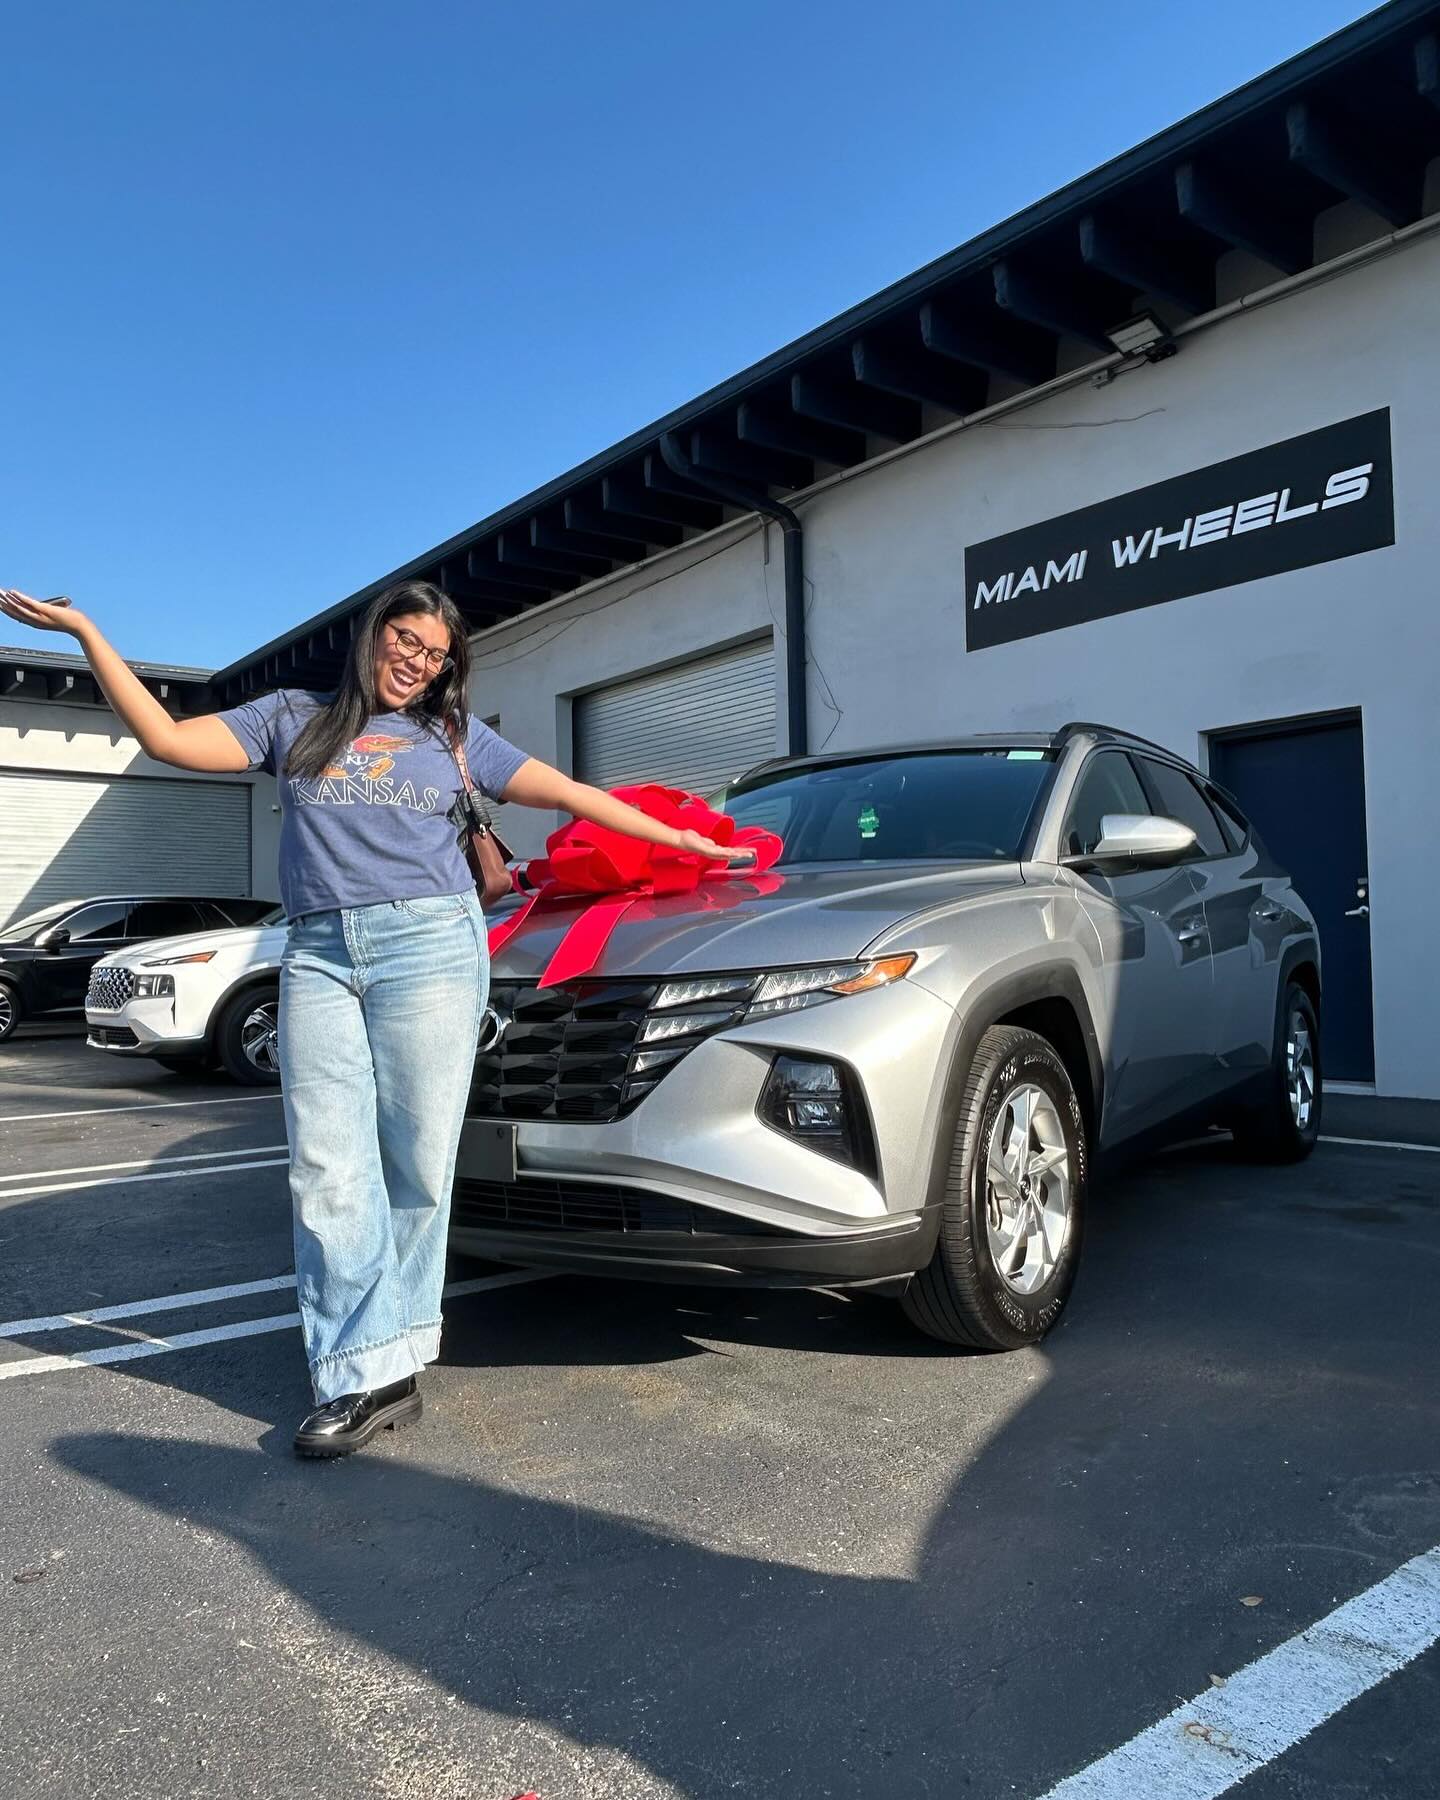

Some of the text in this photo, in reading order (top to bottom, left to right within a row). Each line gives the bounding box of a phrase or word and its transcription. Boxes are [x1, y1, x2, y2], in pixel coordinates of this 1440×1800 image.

[973, 462, 1373, 610] MIAMI WHEELS
[288, 777, 439, 813] KANSAS
